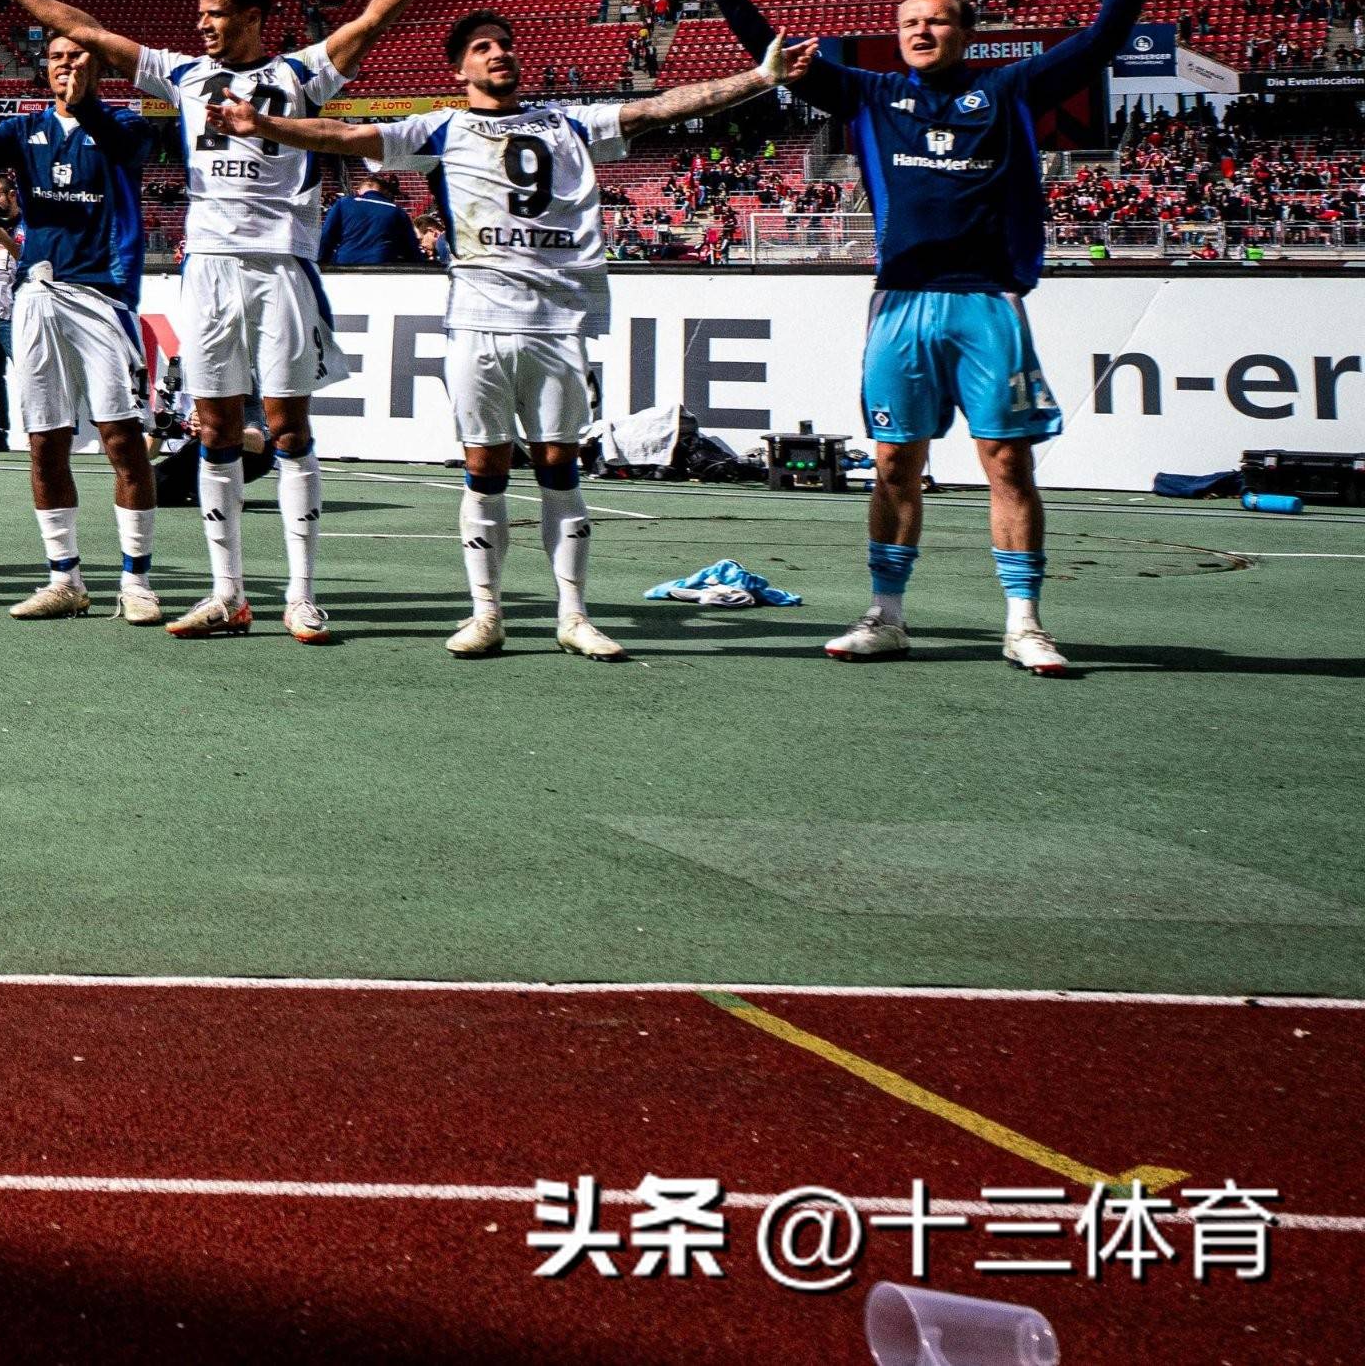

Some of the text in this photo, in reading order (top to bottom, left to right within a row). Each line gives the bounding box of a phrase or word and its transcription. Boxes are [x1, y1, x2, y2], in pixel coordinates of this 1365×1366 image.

[1266, 75, 1365, 87] Die Eventlocation
[324, 101, 352, 111] LOTTO
[382, 100, 412, 111] LOTTO
[211, 159, 261, 180] REIS
[505, 135, 554, 219] 9
[478, 226, 582, 249] GLATZEL
